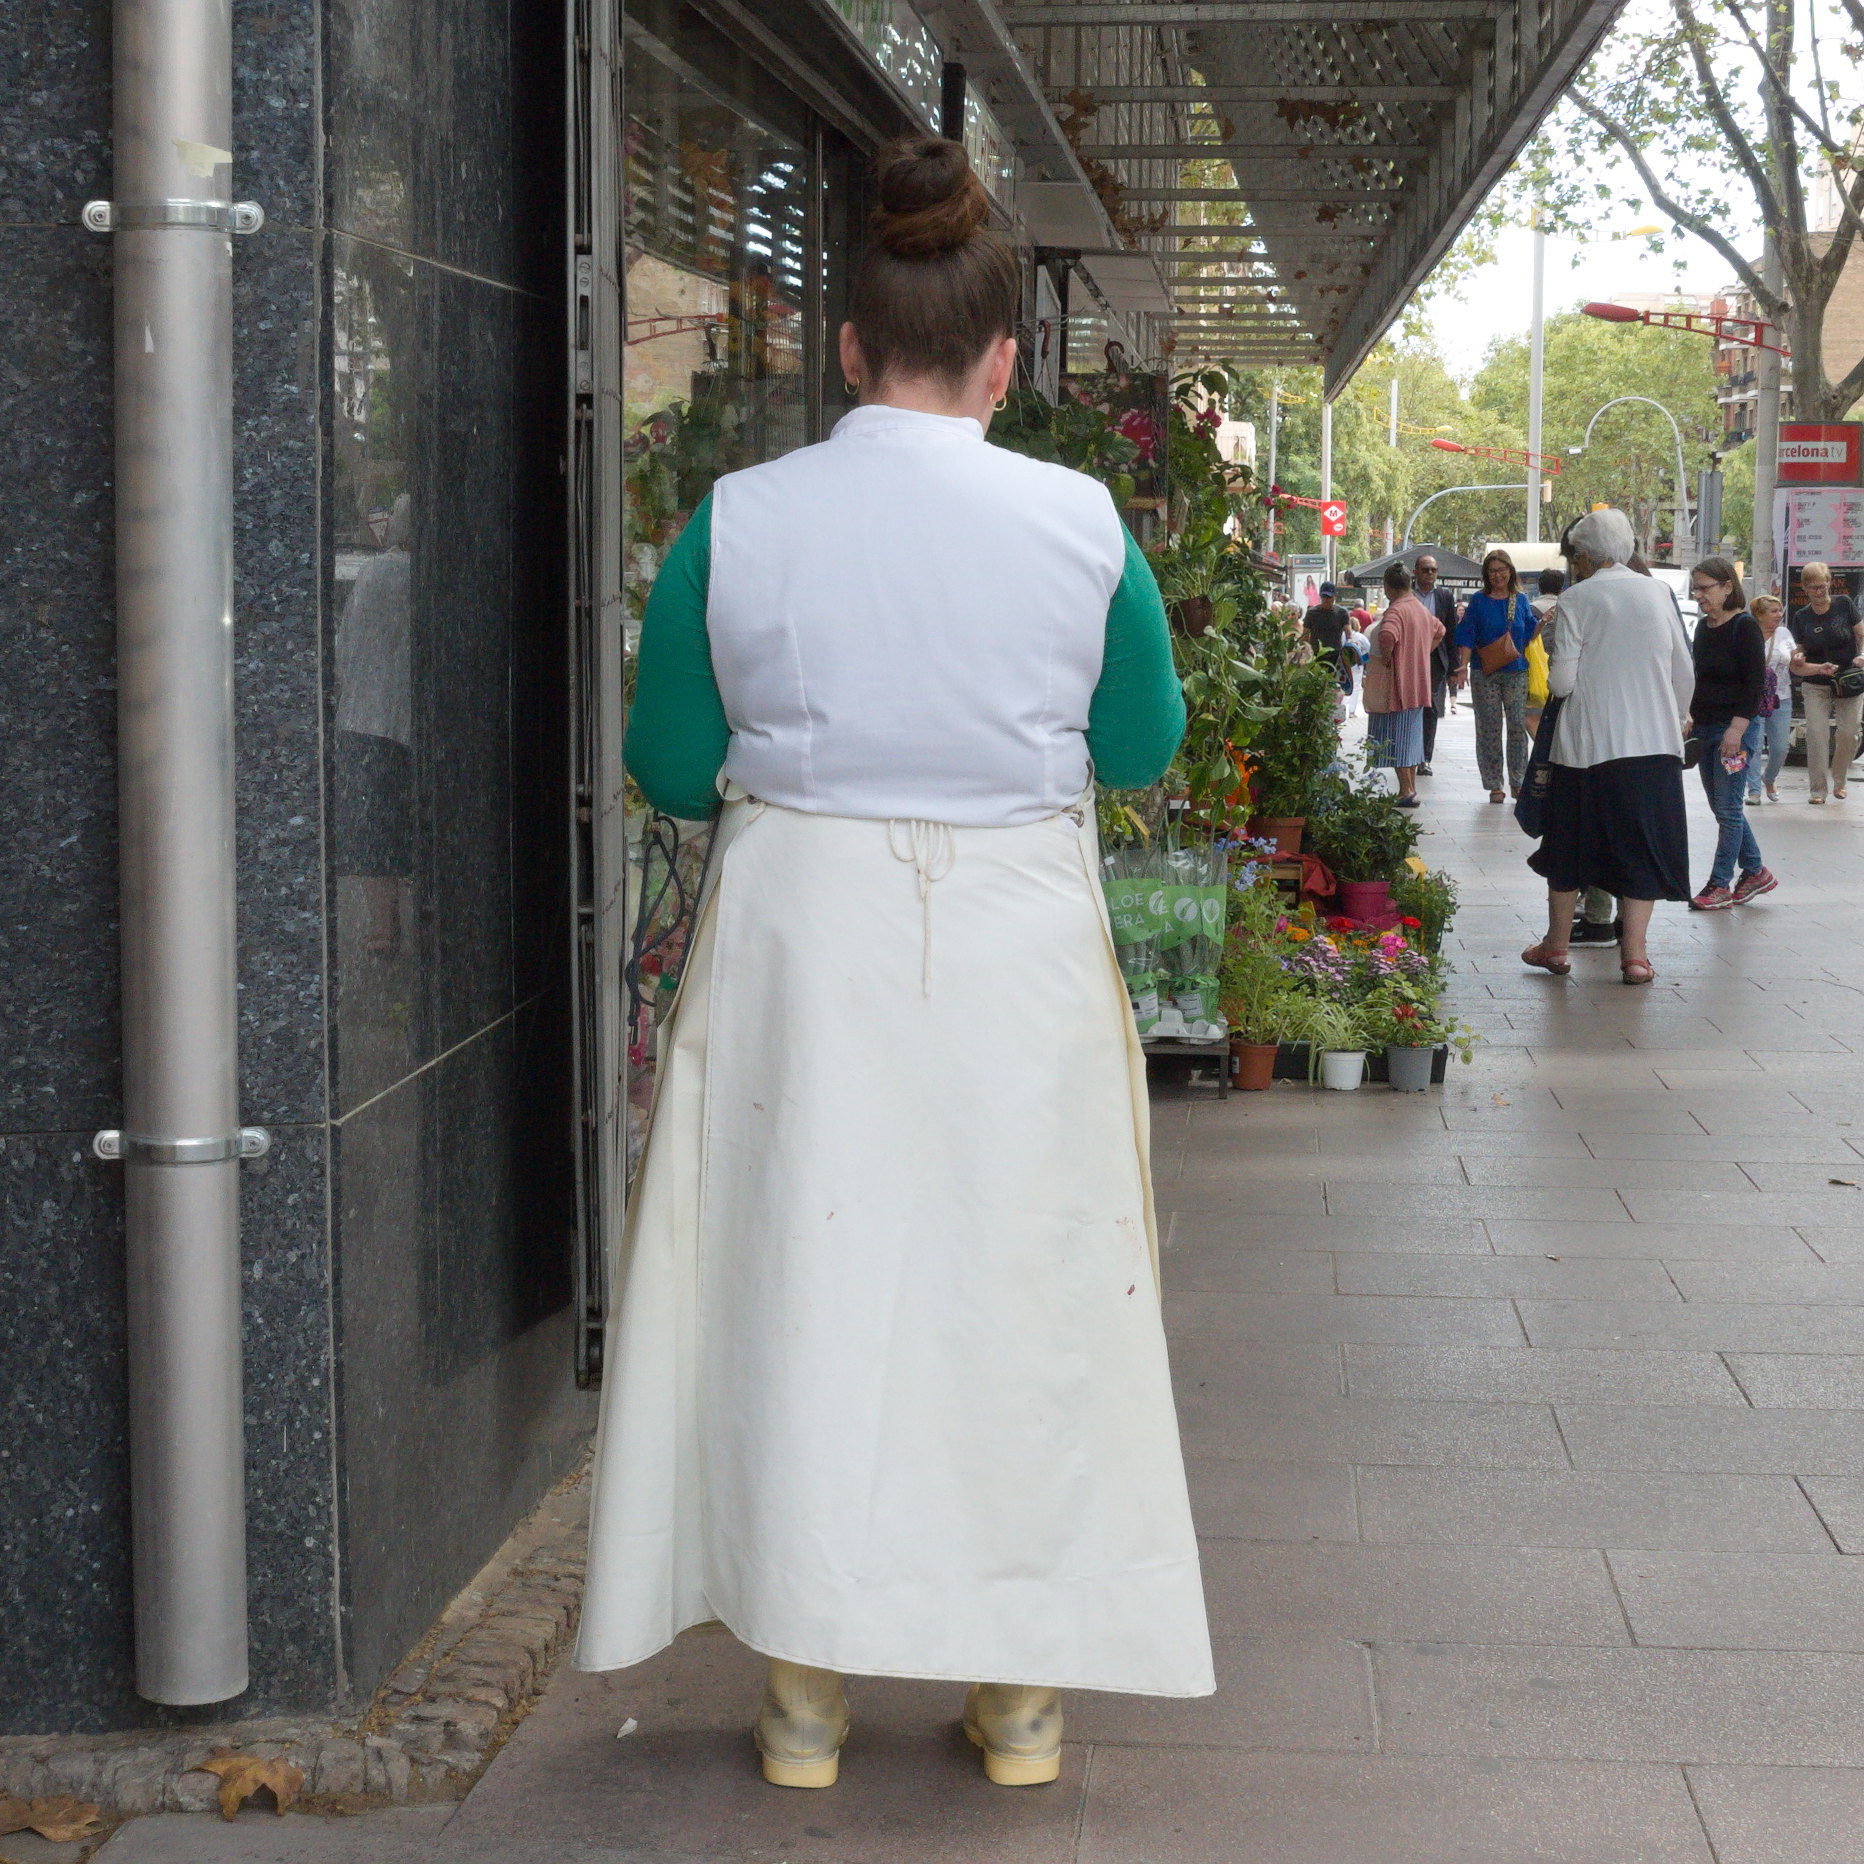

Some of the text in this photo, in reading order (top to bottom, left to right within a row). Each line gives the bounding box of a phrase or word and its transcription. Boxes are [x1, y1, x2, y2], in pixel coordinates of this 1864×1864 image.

[1831, 446, 1843, 458] tv
[1110, 892, 1145, 911] LOE
[1113, 912, 1145, 929] ERA
